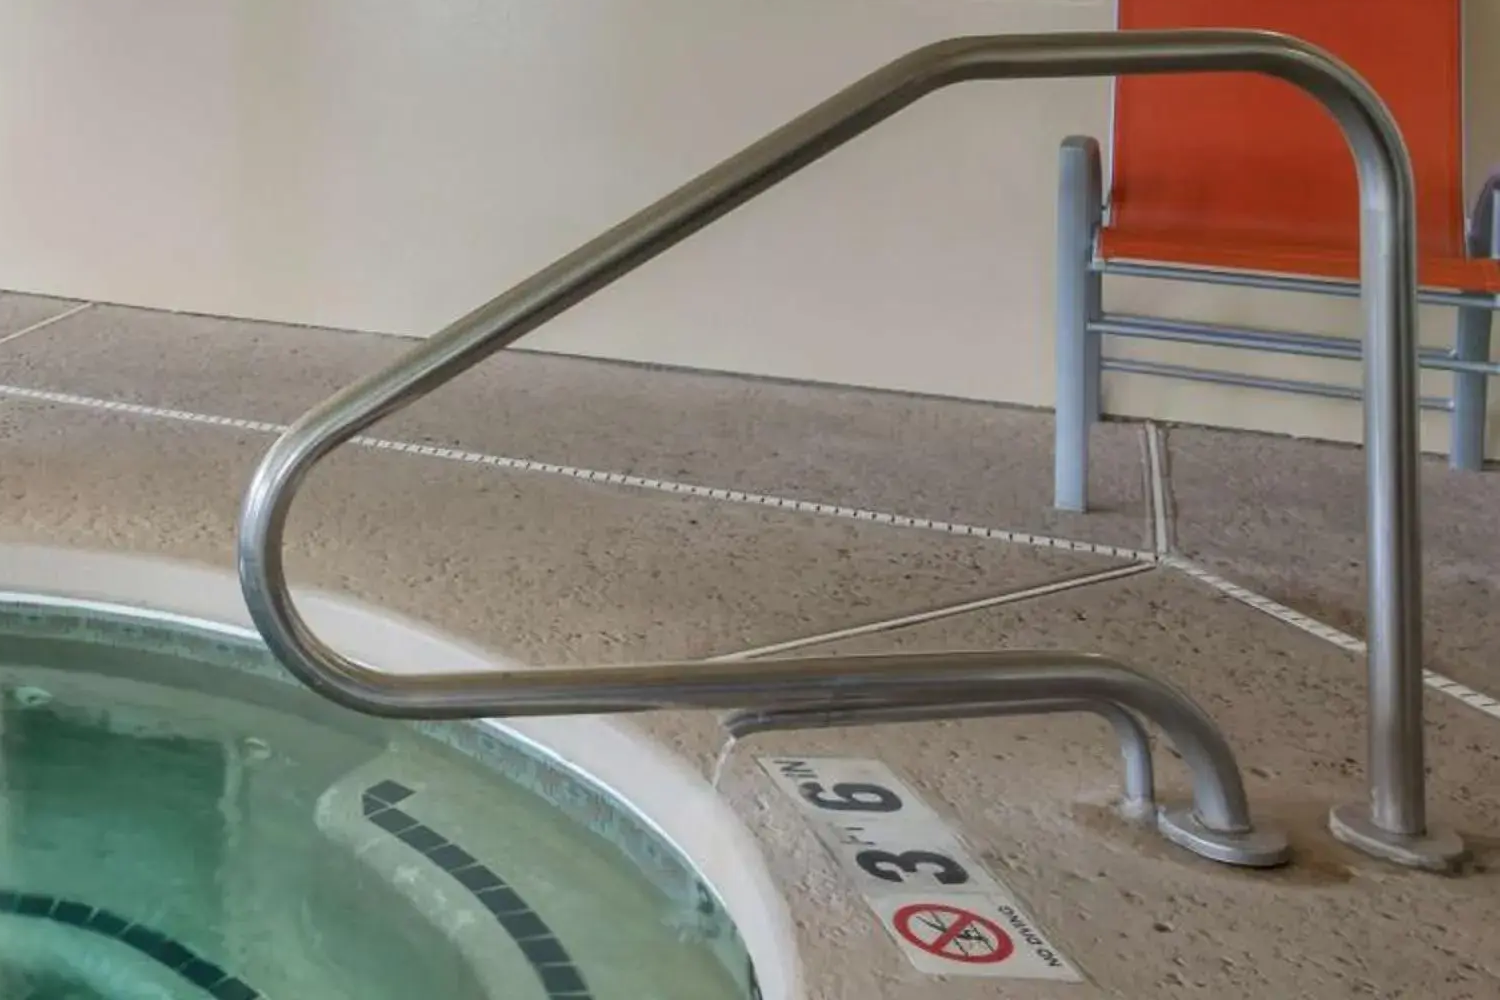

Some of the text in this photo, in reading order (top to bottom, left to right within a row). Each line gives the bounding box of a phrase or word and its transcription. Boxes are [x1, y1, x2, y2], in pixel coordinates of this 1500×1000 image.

[772, 759, 819, 778] IN
[799, 782, 903, 813] 6
[856, 850, 970, 885] 3
[998, 904, 1063, 967] NO DIVING
